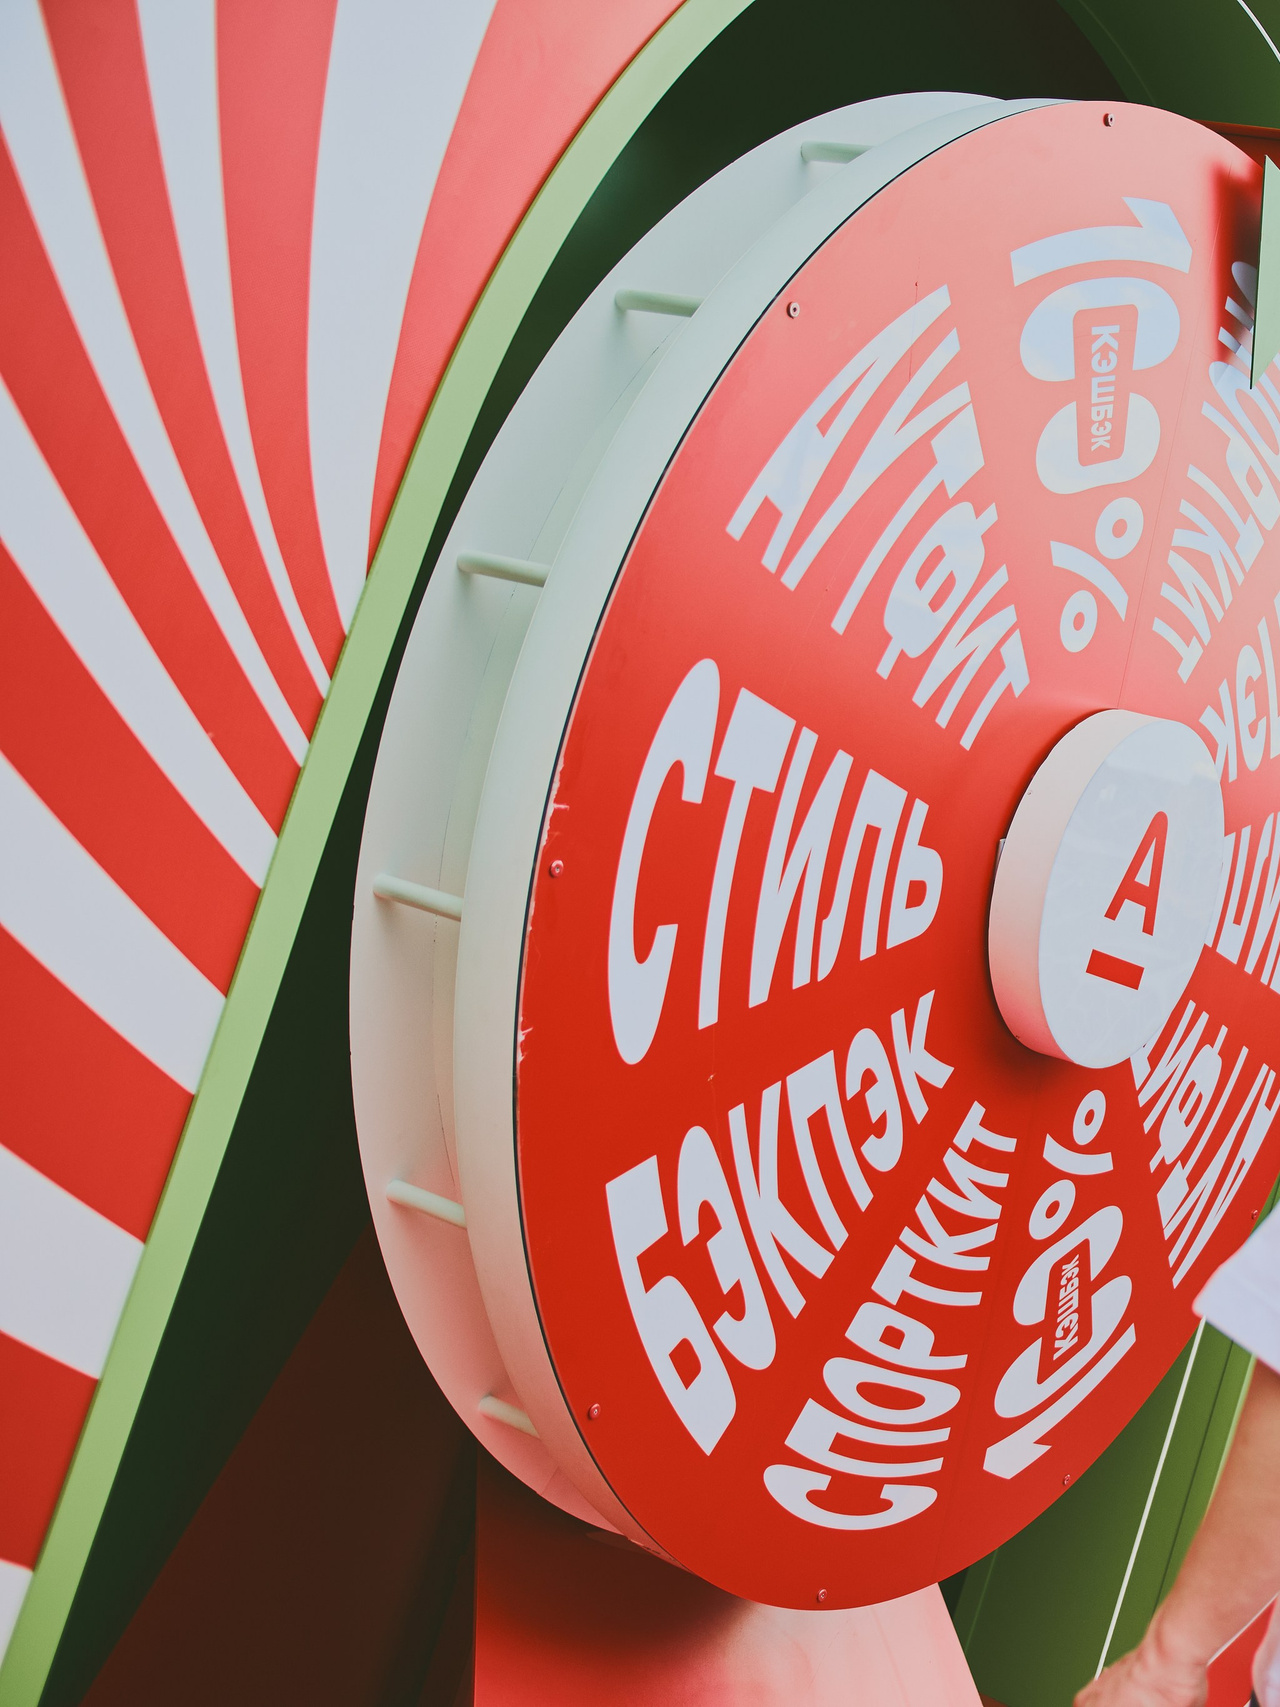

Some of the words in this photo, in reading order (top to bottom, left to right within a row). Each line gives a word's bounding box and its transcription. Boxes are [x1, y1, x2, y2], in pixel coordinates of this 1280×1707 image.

[726, 284, 1030, 751] АУТФИТ
[1010, 197, 1192, 652] 100%
[1091, 325, 1120, 451] КЭШБЭК
[608, 659, 943, 1065] СТИЛЬ
[606, 989, 954, 1456] БЭКПЭК
[763, 1100, 1017, 1530] СПОРТКИТ
[982, 1089, 1136, 1480] 100%
[1053, 1254, 1079, 1361] КЭШБЭК
